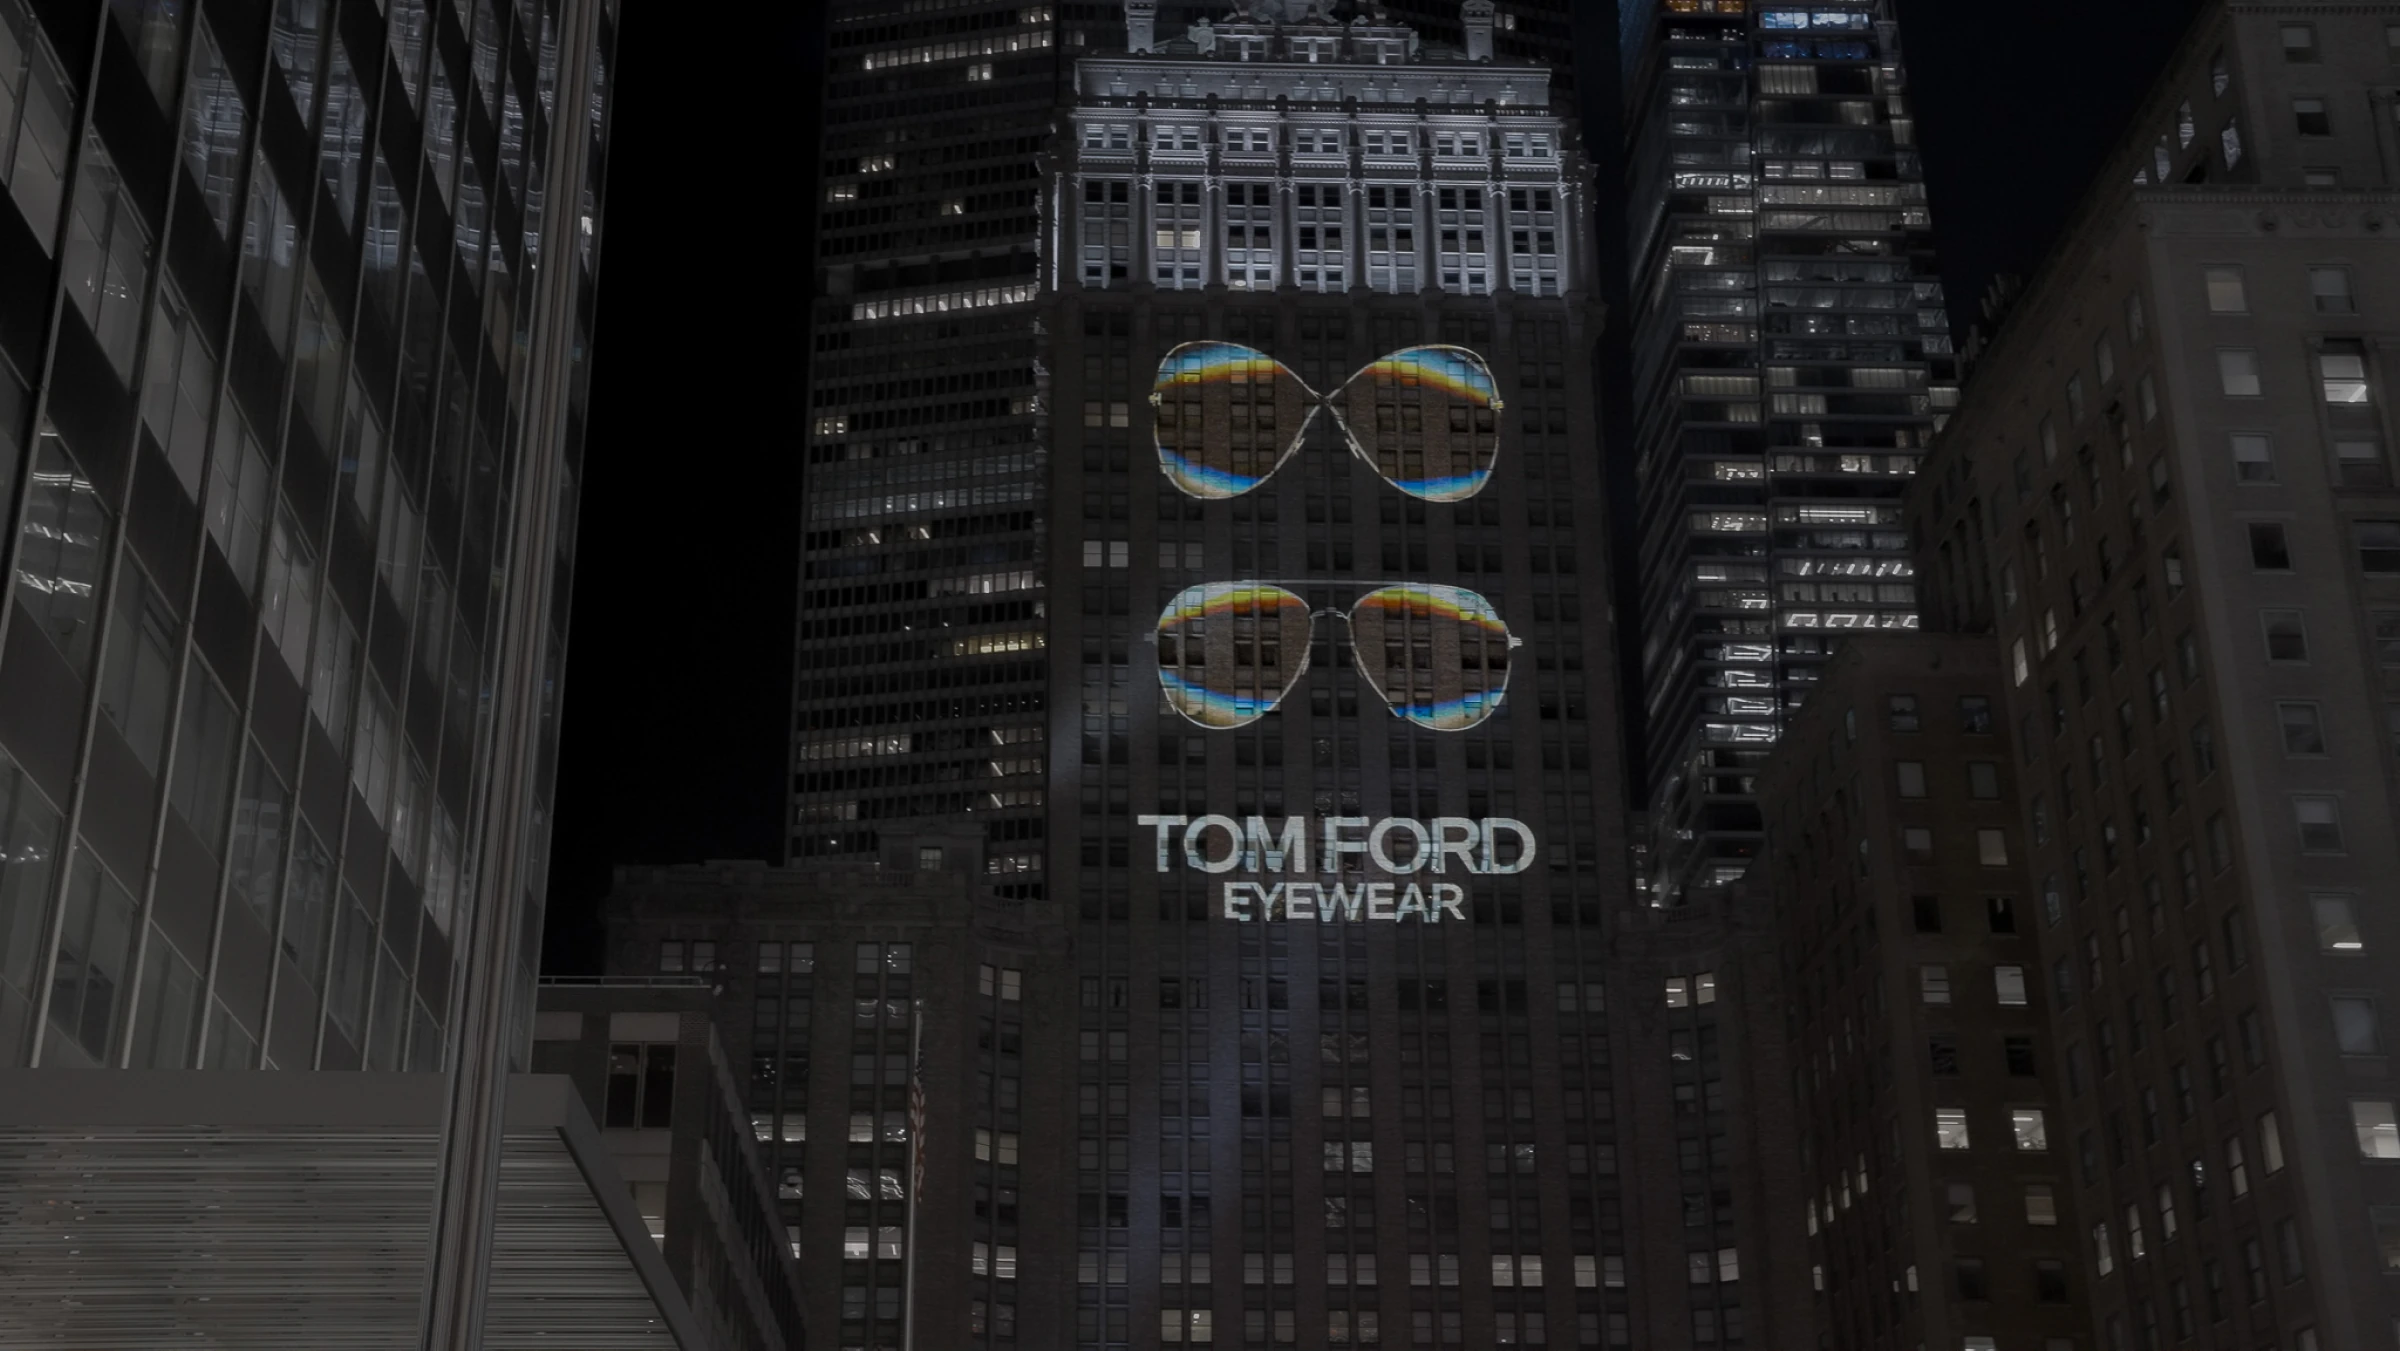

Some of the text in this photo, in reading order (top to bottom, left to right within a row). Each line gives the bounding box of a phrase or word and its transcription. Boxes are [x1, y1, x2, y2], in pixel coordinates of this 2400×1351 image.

[1137, 814, 1537, 875] TOM FORD
[1224, 881, 1466, 923] EYEWEAR
